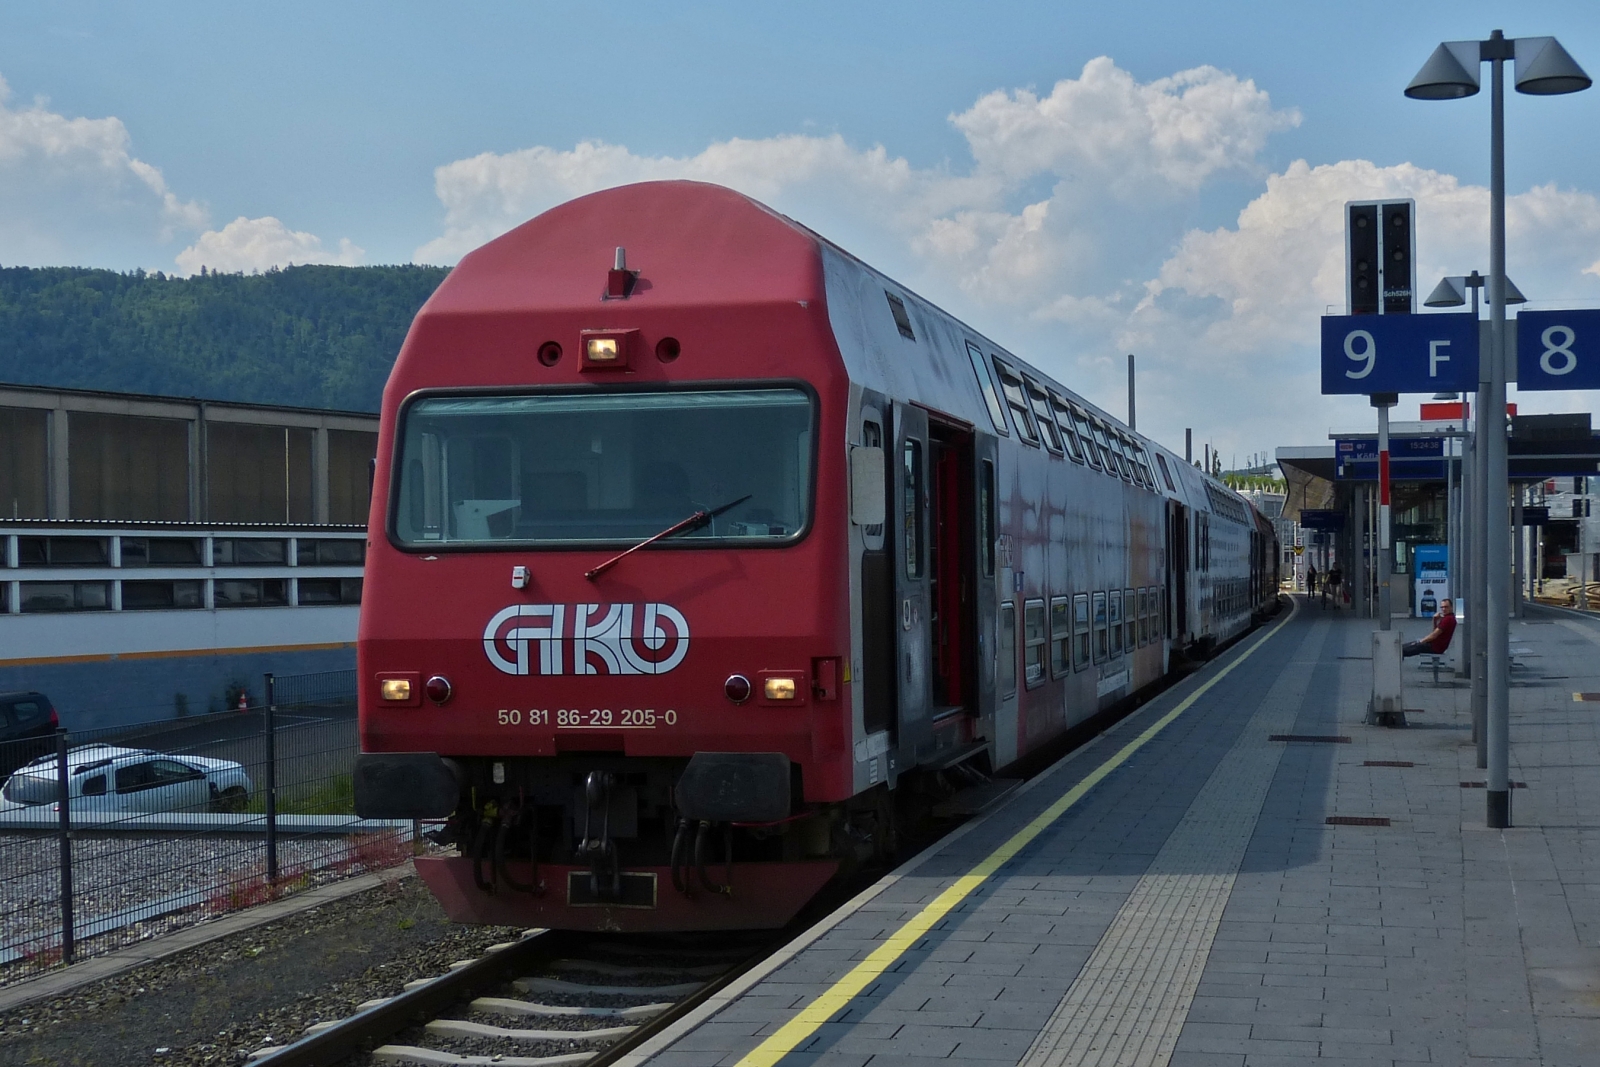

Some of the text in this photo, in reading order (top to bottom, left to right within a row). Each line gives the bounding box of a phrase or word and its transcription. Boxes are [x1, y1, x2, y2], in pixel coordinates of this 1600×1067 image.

[1343, 330, 1451, 379] 9 F
[1539, 325, 1578, 375] 8
[498, 709, 677, 725] 50 81 86-29 205-0
